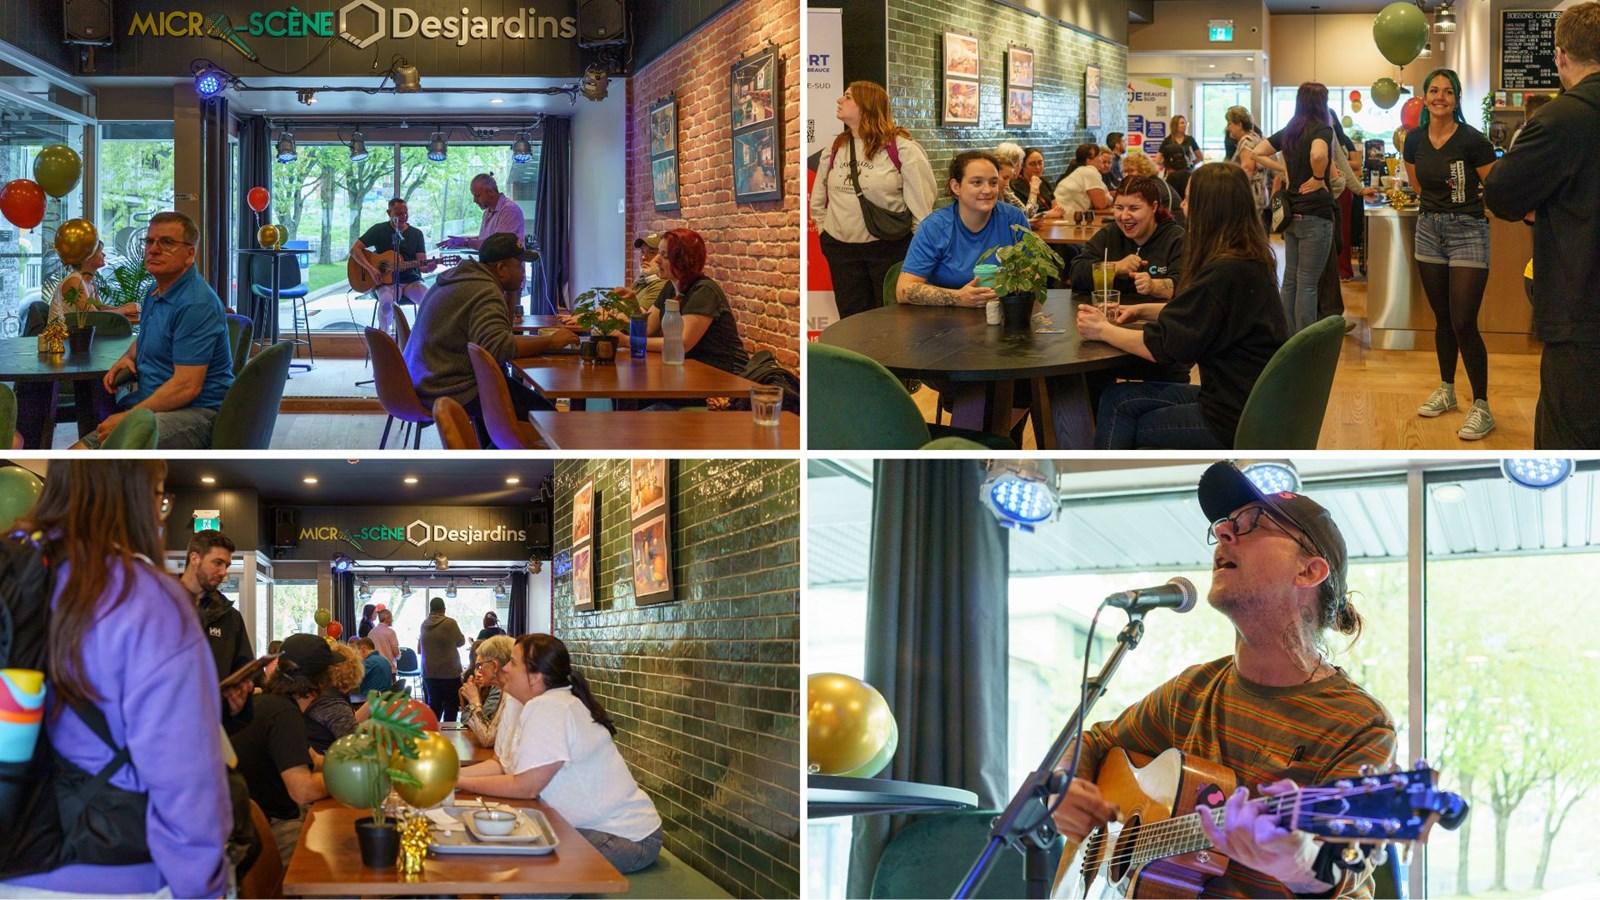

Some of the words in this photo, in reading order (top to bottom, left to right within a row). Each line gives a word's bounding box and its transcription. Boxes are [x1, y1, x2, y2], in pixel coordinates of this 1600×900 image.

[392, 7, 577, 46] Desjardins
[807, 54, 830, 66] RT
[433, 525, 527, 546] Desjardins
